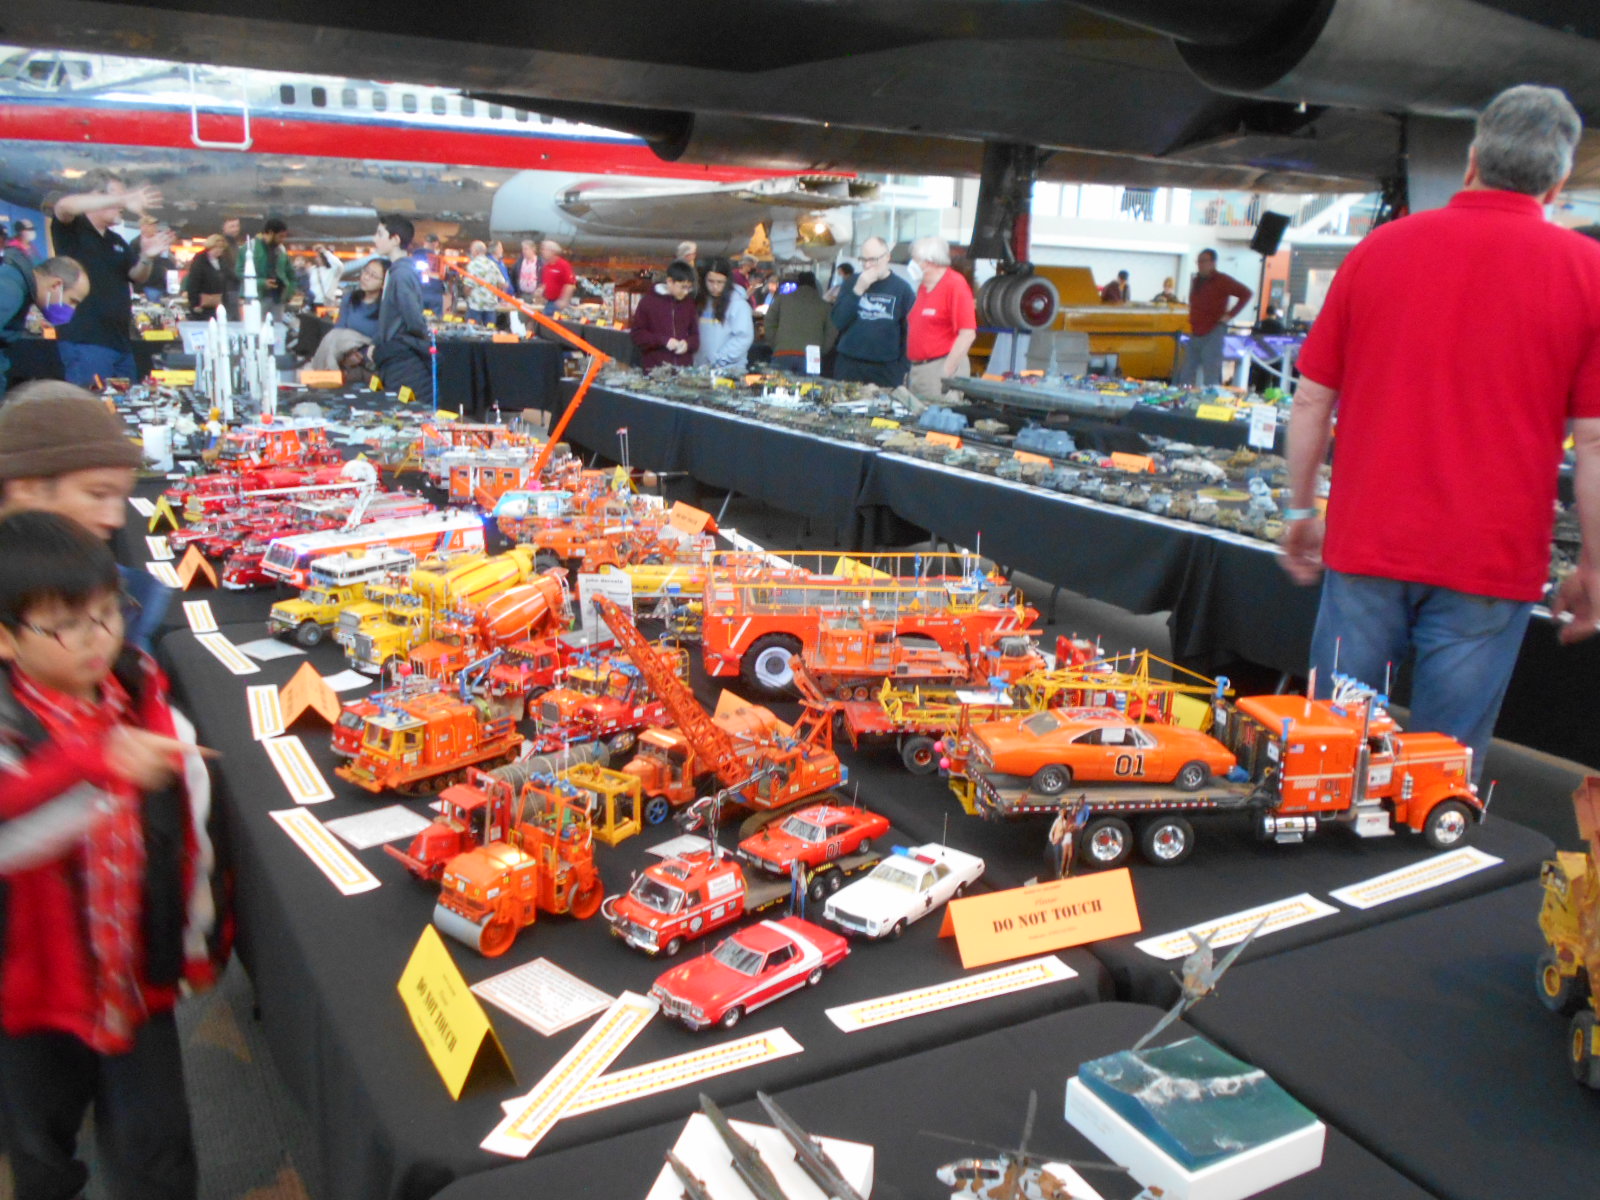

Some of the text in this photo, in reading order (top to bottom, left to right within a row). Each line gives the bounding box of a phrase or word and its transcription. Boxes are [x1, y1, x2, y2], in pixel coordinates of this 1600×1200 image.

[453, 533, 461, 547] 4
[1115, 753, 1145, 777] 01
[826, 840, 841, 859] 01
[992, 917, 1014, 934] DO
[1018, 910, 1048, 929] NOT
[1052, 898, 1103, 921] TOUCH
[417, 976, 427, 996] DO
[424, 990, 438, 1017] NOT
[434, 1009, 458, 1054] TOUCH
